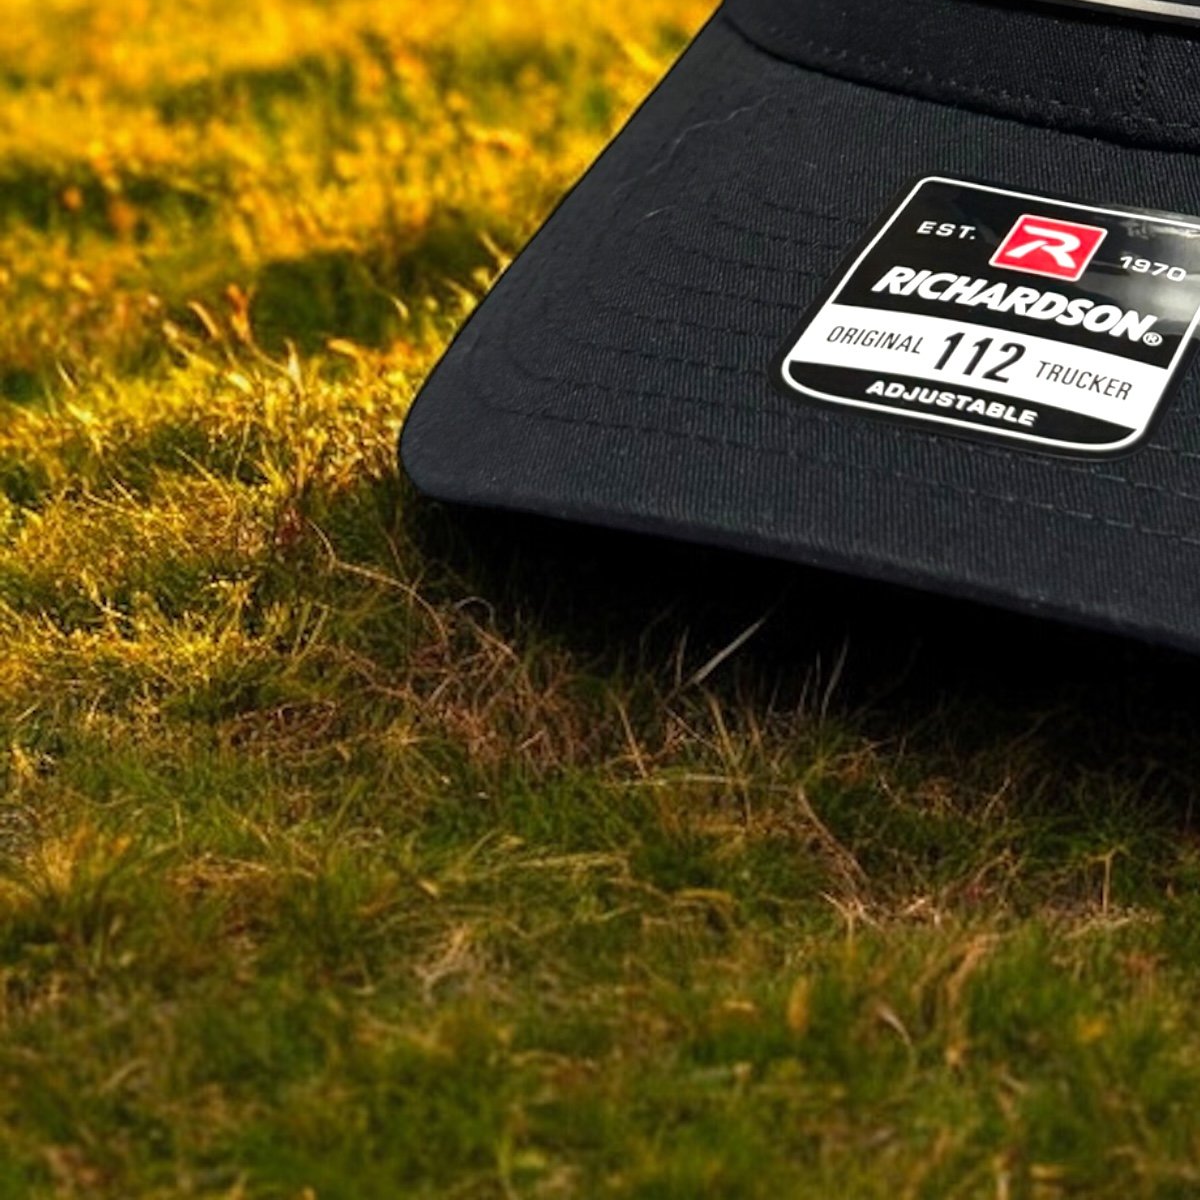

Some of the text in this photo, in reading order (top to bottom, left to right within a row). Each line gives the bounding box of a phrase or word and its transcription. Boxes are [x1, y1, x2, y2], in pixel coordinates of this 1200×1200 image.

[917, 220, 976, 240] EST.
[1120, 255, 1187, 282] 1970
[826, 325, 1133, 401] ORIGINAL 112 TRUCKER
[865, 380, 1039, 427] ADJUSTABLE
